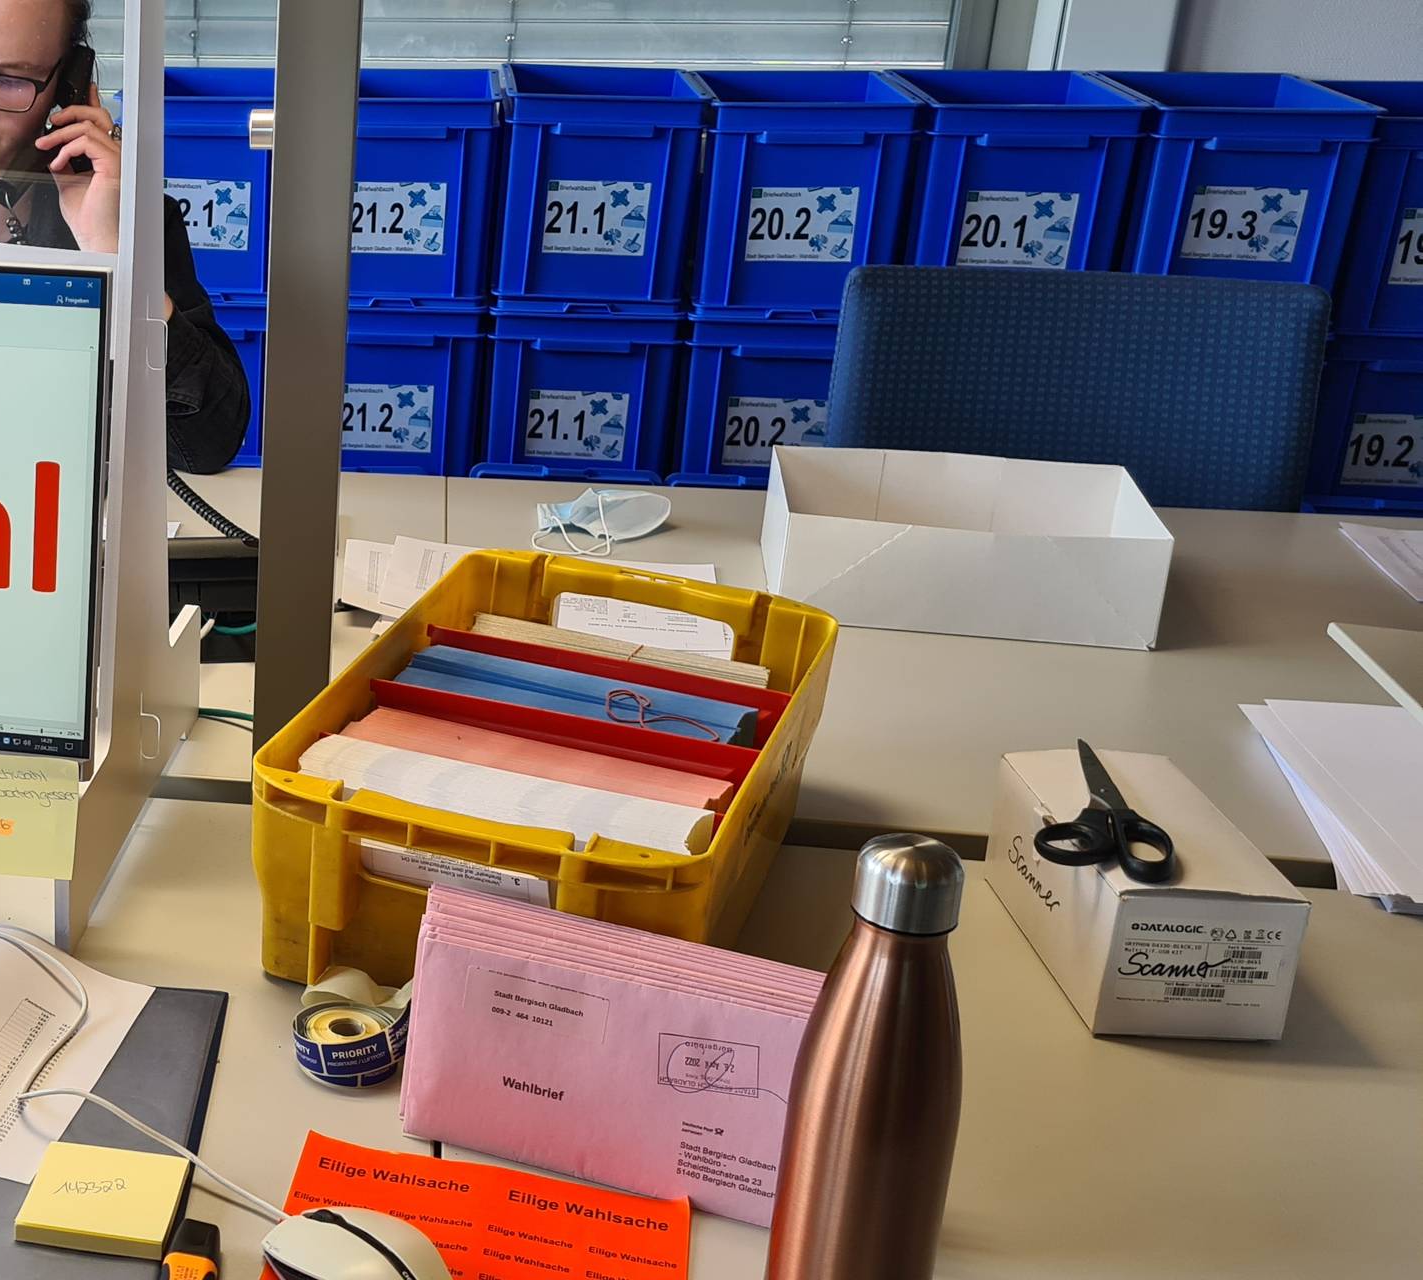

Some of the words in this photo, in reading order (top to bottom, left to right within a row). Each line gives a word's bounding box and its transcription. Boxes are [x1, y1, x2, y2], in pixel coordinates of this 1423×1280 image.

[178, 198, 214, 228] 2.1
[352, 202, 404, 233] 21.2
[545, 201, 606, 235] 21.1
[749, 207, 811, 240] 20.2
[1191, 208, 1257, 240] 19.3
[961, 214, 1028, 248] 20.1
[342, 402, 393, 432] 21.2
[527, 408, 586, 441] 21.1
[725, 416, 786, 447] 20.2
[1350, 433, 1414, 467] 19.2
[1007, 835, 1061, 911] Scanner
[1140, 923, 1205, 934] DATALOGIC
[1118, 951, 1231, 979] Scanner
[491, 1006, 512, 1016] 009-2
[532, 1016, 553, 1027] 10121
[494, 990, 514, 1001] Stadt
[514, 995, 547, 1009] Bergisch
[548, 1003, 584, 1017] Gladbach
[331, 1043, 378, 1060] PRIORITY
[502, 1075, 565, 1101] Wahlbrief
[680, 1141, 701, 1153] Stadt
[702, 1146, 737, 1161] Bergisch
[738, 1156, 777, 1172] Gladbach
[683, 1151, 722, 1167] Wahlbüro
[318, 1156, 367, 1178] Eilige
[372, 1168, 470, 1193] Wahlsache
[676, 1167, 701, 1179] 51460
[702, 1174, 736, 1189] Bergisch
[737, 1183, 776, 1198] Gladbach
[677, 1158, 750, 1183] Scheidtbachstraße
[751, 1177, 762, 1186] 23
[293, 1190, 321, 1203] Eilige
[508, 1189, 560, 1211] Eilige
[564, 1201, 669, 1231] Wahlsache
[388, 1209, 417, 1221] Eilige
[419, 1214, 473, 1228] Wahlsache
[487, 1224, 516, 1237] Eilige
[518, 1231, 573, 1249] Wahlsache
[482, 1248, 512, 1261] Eilige
[514, 1254, 570, 1274] Wahlsache
[588, 1246, 618, 1258] Eilige
[620, 1252, 678, 1269] Wahlsache
